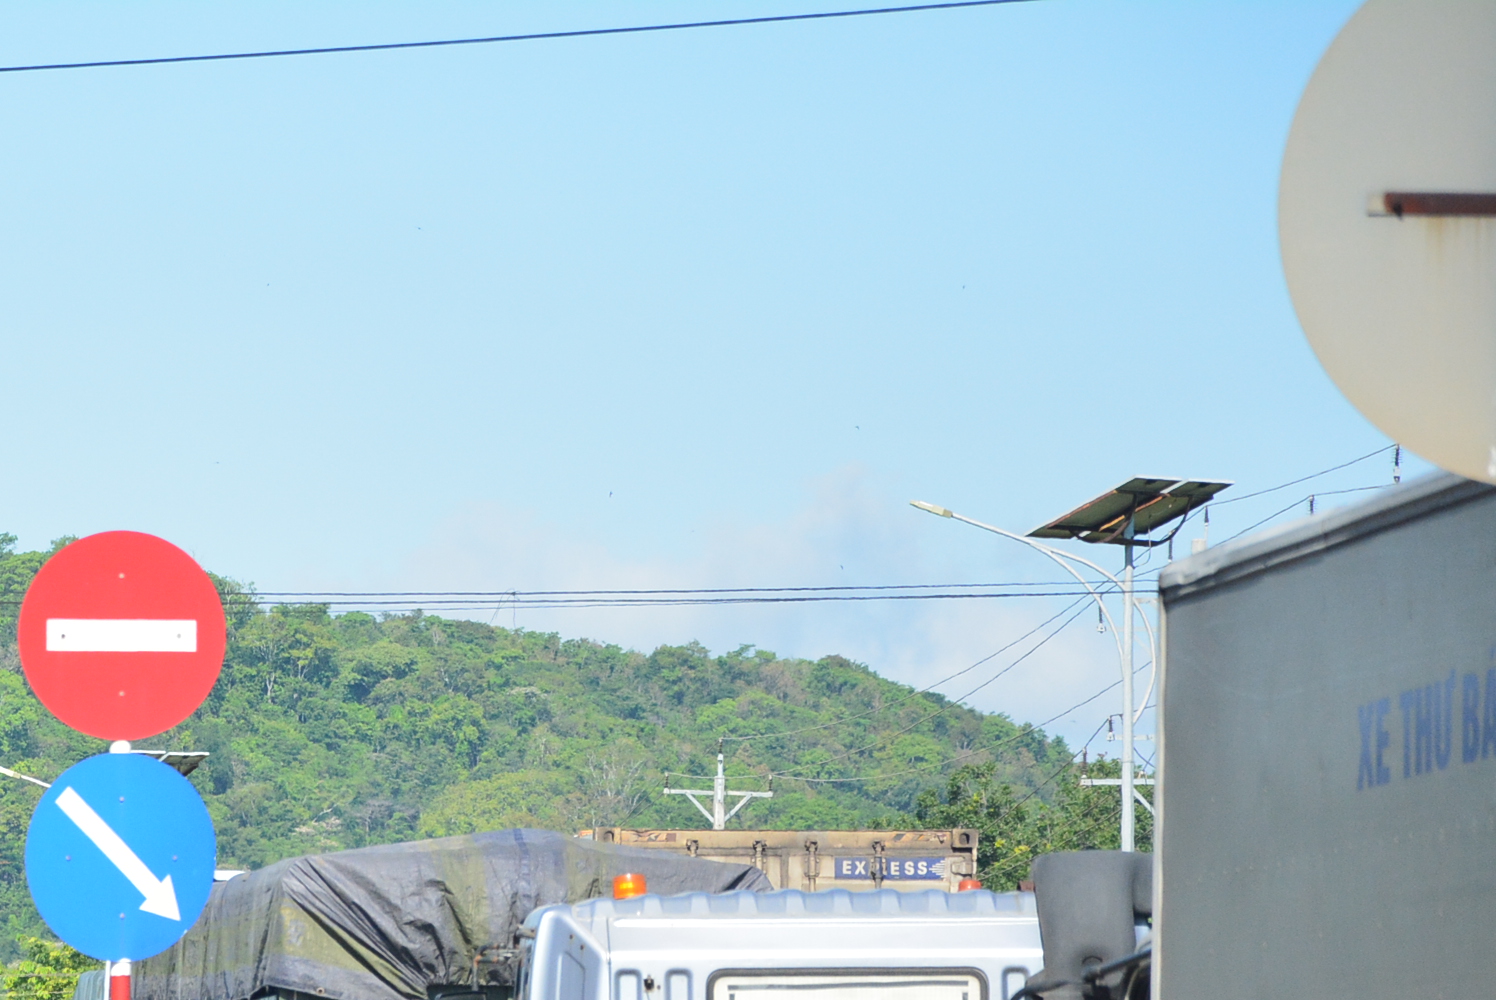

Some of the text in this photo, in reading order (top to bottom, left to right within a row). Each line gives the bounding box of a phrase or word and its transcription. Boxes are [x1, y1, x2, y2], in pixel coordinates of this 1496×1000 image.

[1357, 696, 1391, 791] XE
[1399, 668, 1456, 779] THƯ
[842, 860, 928, 875] EXESS
